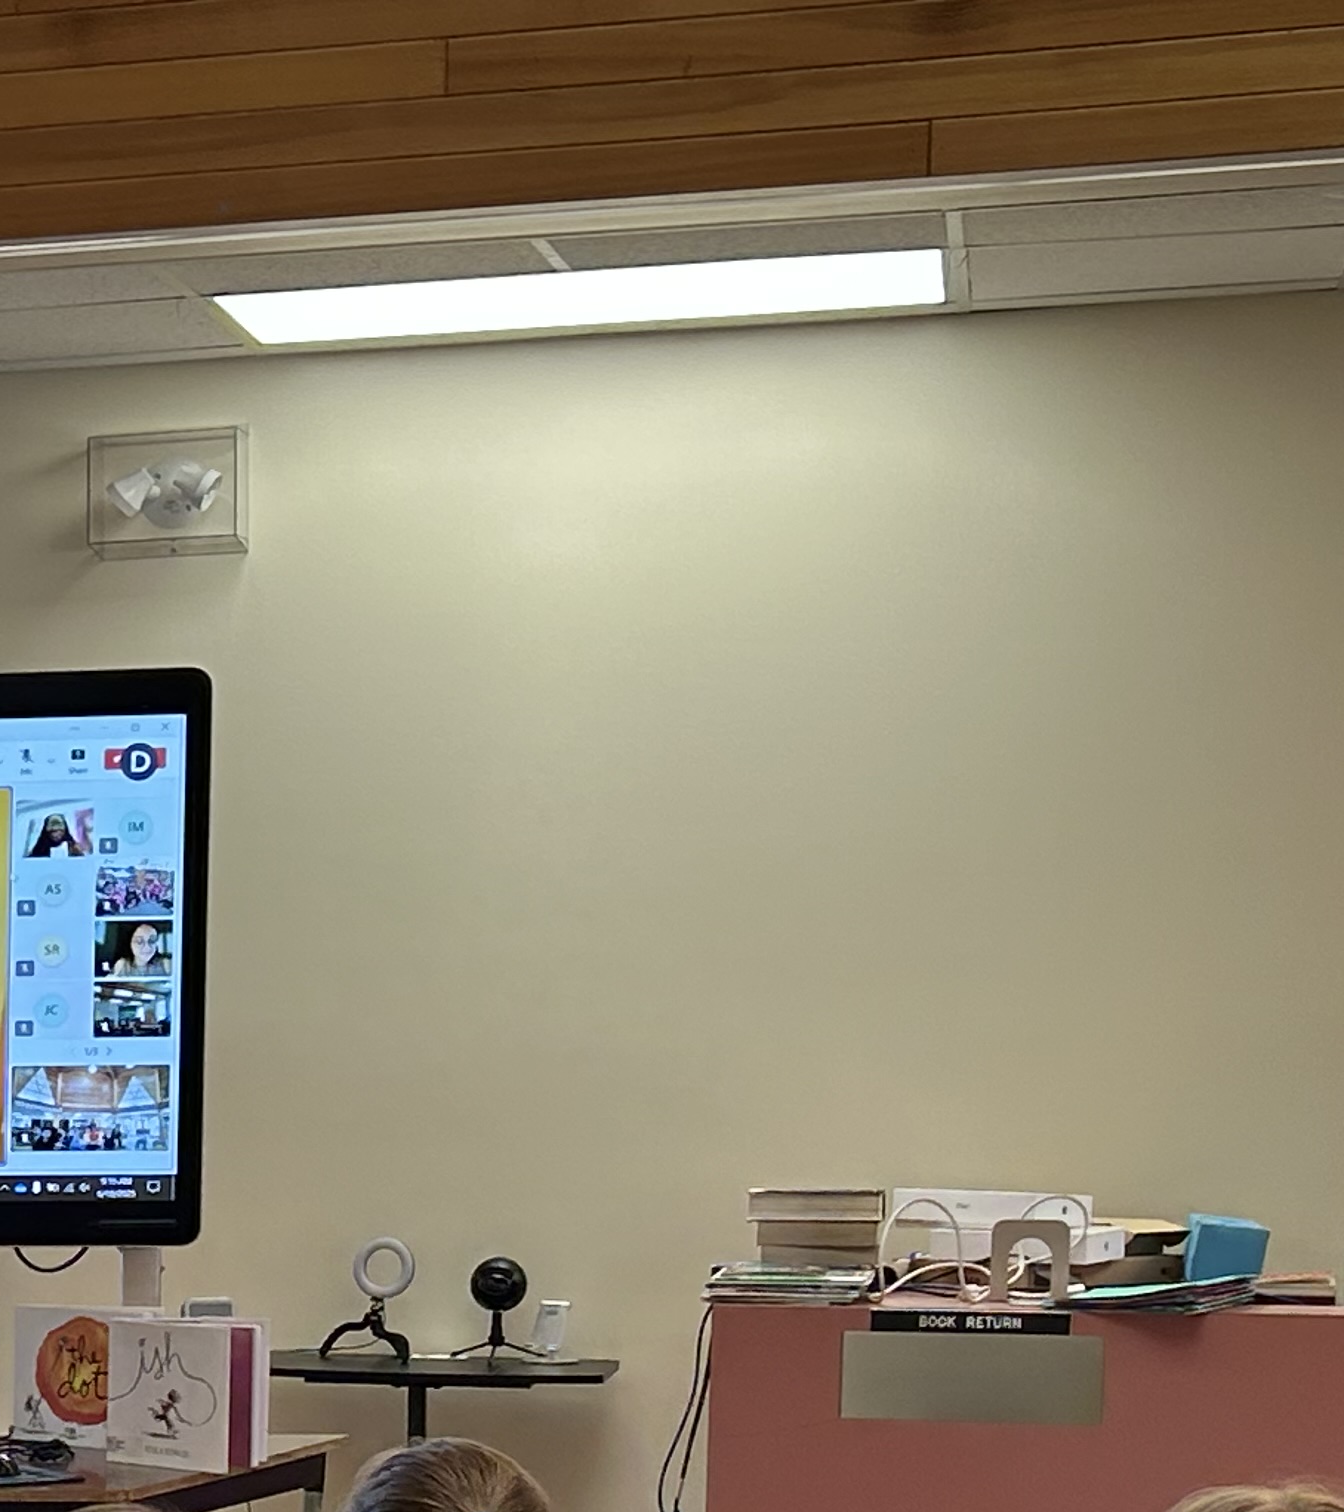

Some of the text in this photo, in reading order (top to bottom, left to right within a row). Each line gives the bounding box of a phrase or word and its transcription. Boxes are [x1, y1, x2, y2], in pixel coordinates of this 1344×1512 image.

[130, 750, 152, 773] D
[918, 1315, 1023, 1330] BOOK RETURN
[64, 1334, 103, 1365] the
[137, 1330, 181, 1381] ish
[57, 1362, 109, 1401] dot
